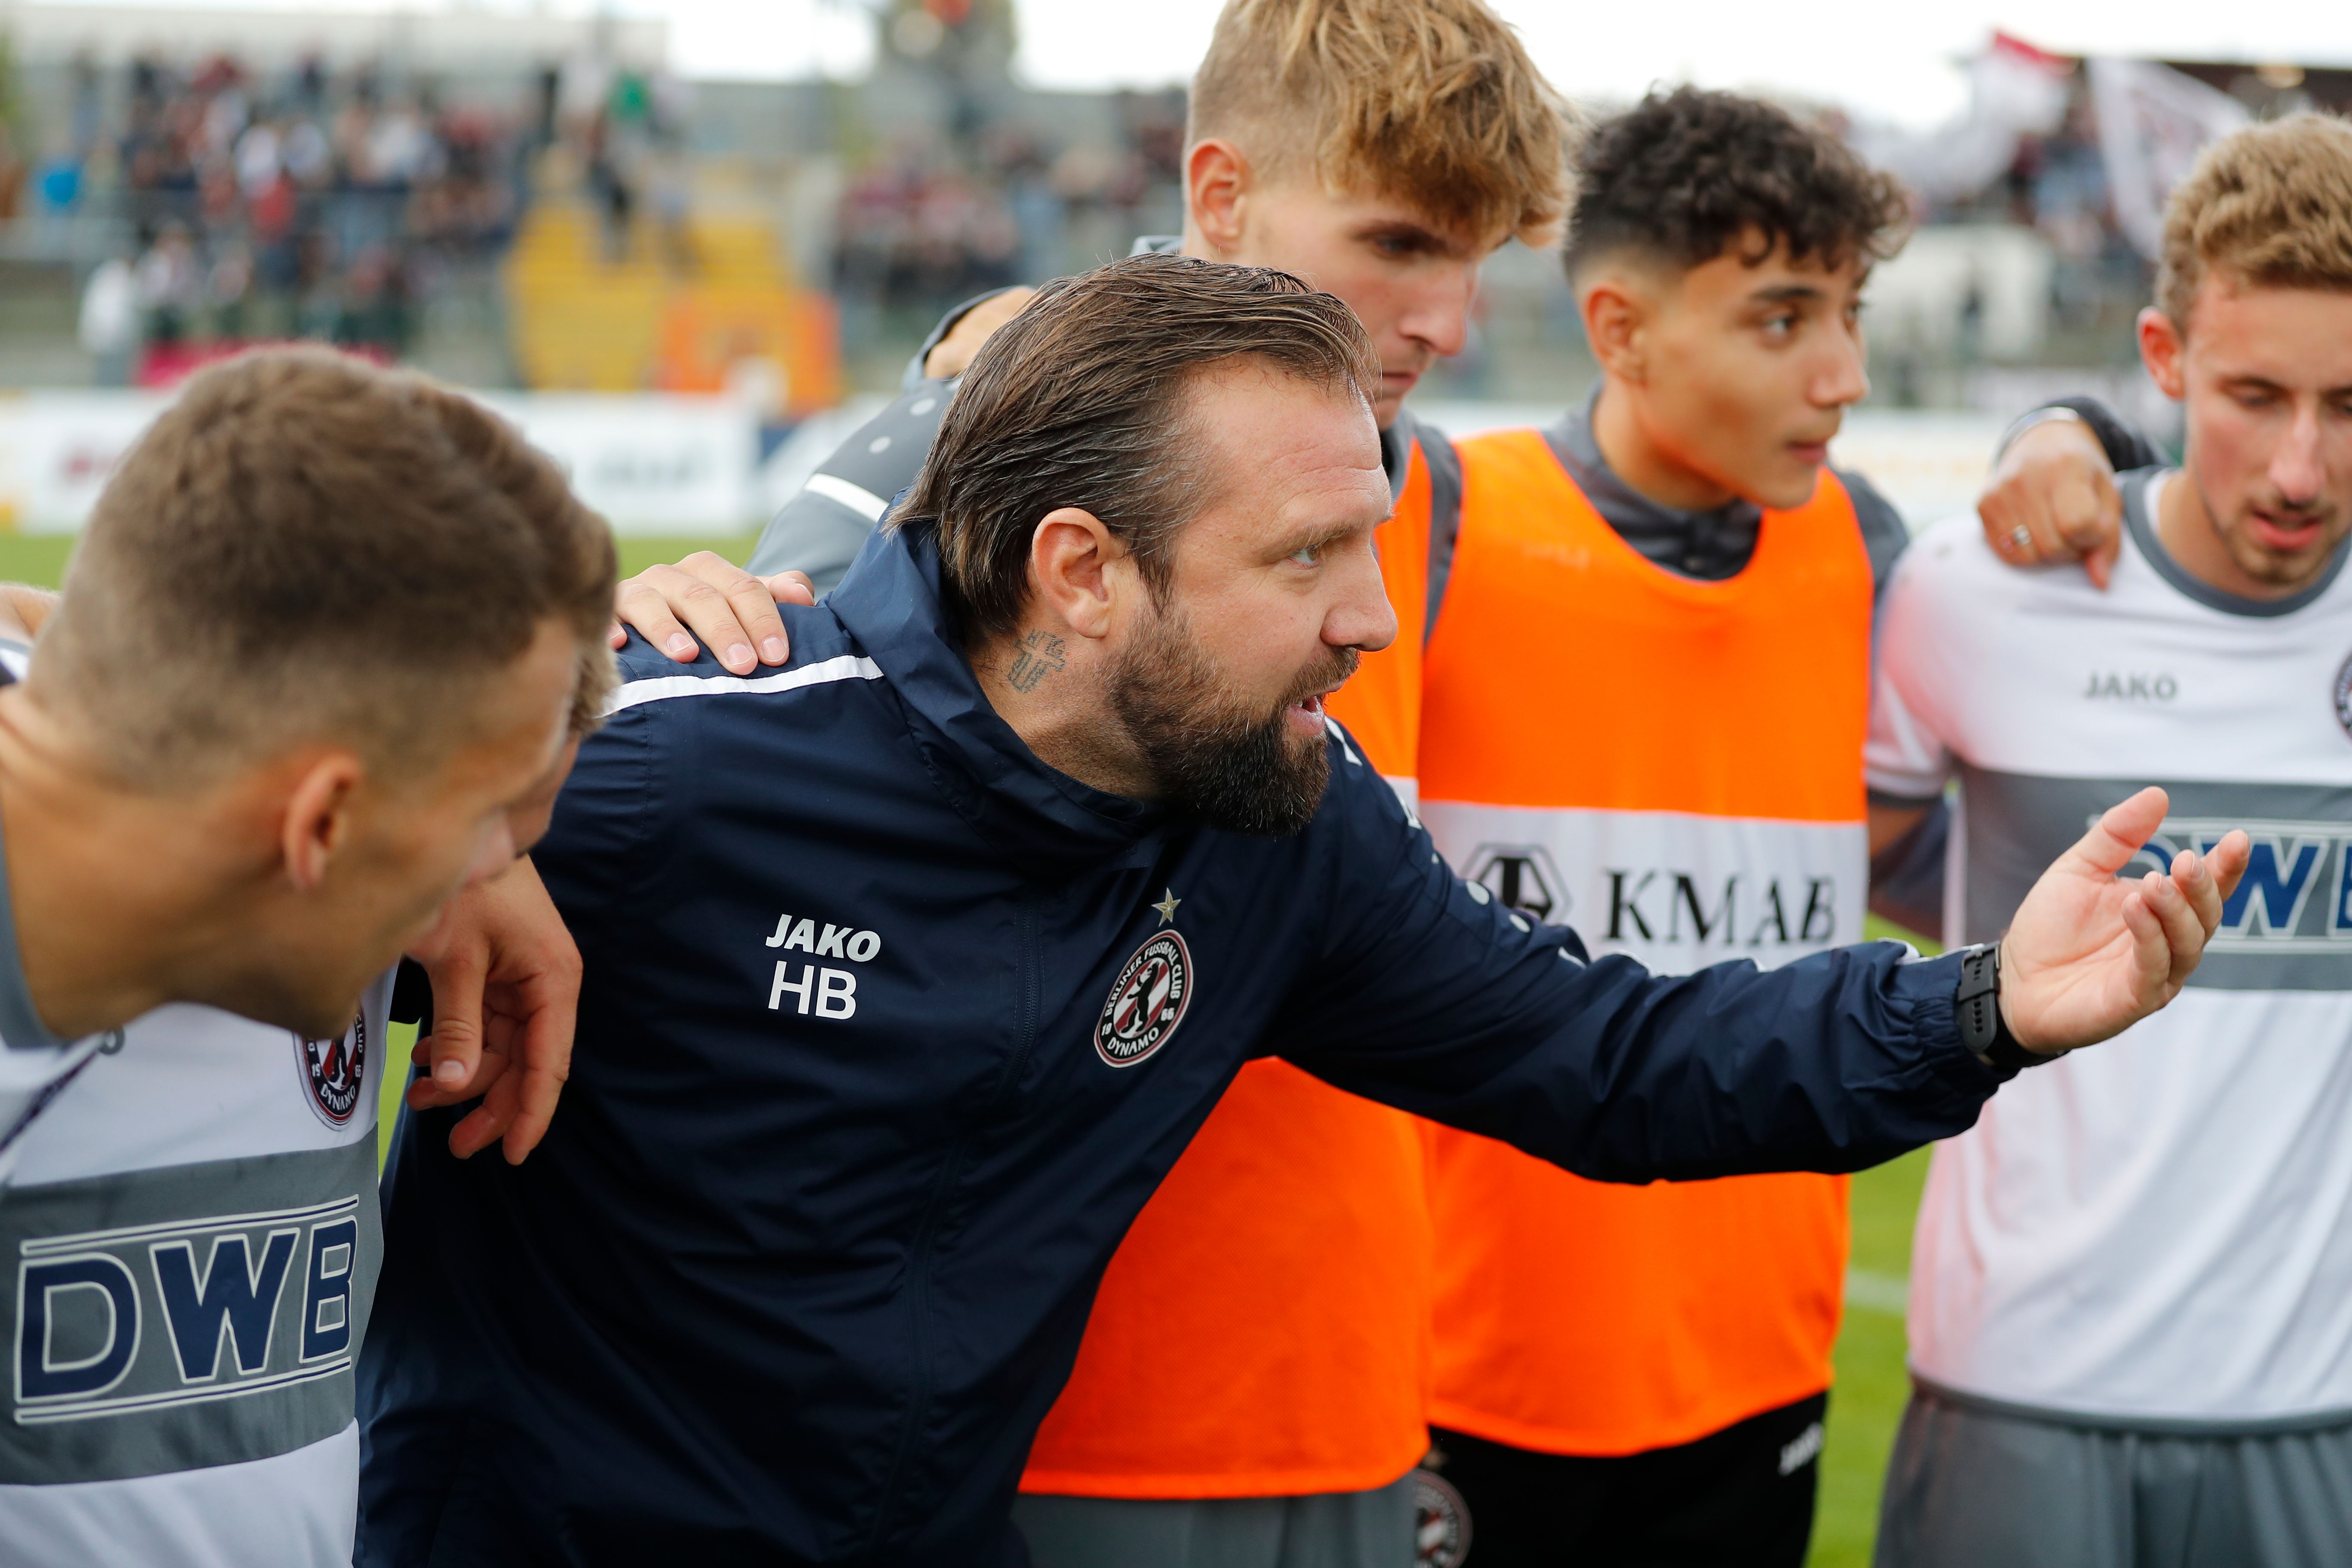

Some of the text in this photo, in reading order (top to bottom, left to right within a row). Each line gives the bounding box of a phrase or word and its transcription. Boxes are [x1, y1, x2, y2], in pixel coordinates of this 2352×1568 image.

[2082, 672, 2178, 701] JAKO
[1602, 867, 1836, 945] KMAB
[766, 914, 881, 962] JAKO
[768, 960, 857, 1020] HB
[1105, 941, 1182, 1017] BERLINER FUSSBALL CLUB
[1101, 1008, 1175, 1036] 19 66
[1107, 1027, 1159, 1056] DYNAMO
[321, 1083, 355, 1110] DYNAMO
[14, 1215, 358, 1404] DWB
